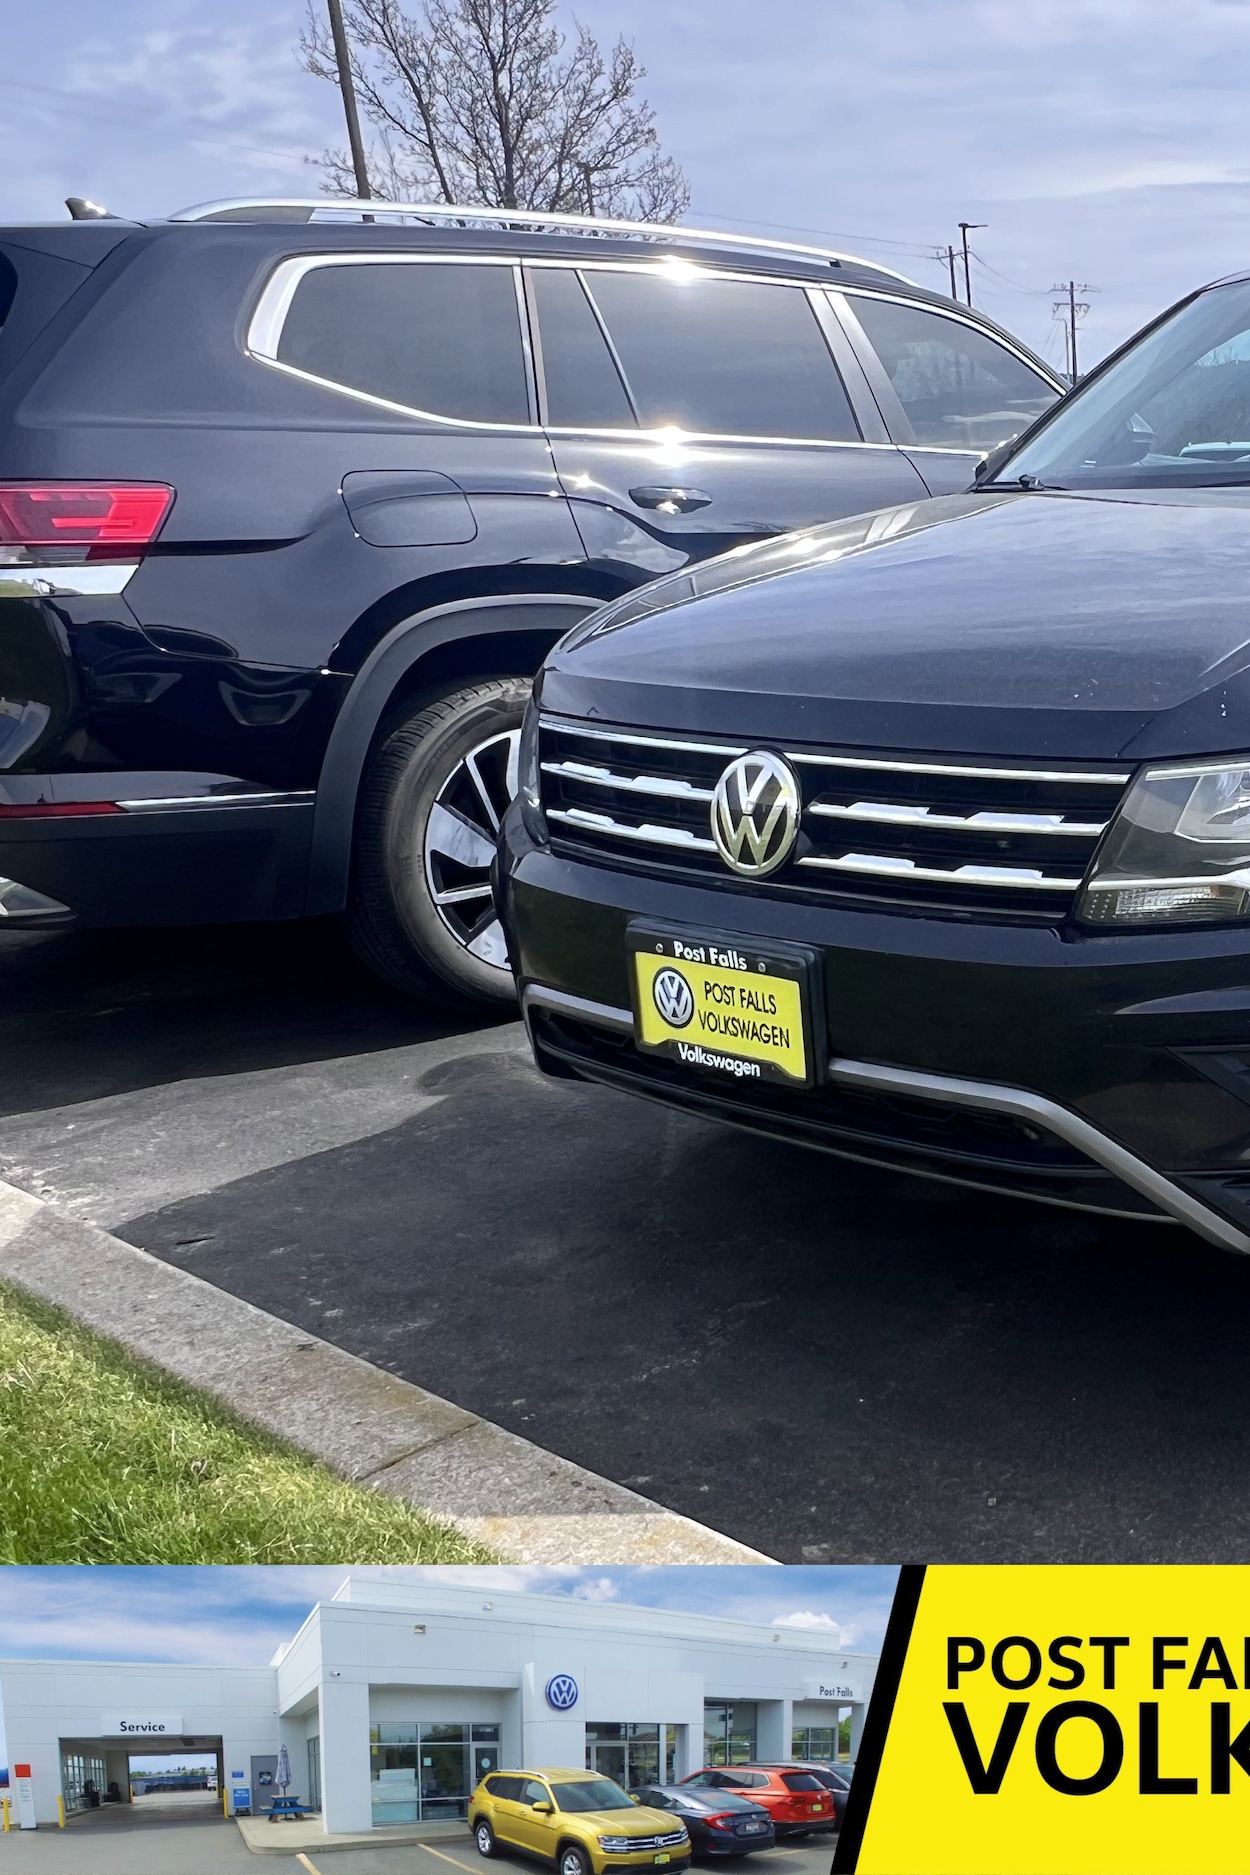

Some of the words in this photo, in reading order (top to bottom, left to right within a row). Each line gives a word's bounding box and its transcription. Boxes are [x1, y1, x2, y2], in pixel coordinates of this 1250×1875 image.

[711, 750, 801, 876] VW
[673, 941, 706, 962] Post
[709, 947, 748, 970] Falls
[653, 966, 694, 1028] VW
[704, 980, 735, 1007] POST
[739, 987, 777, 1015] FALLS
[698, 1009, 790, 1049] VOLKSWAGEN
[678, 1043, 761, 1077] Volkswagen
[548, 1674, 578, 1710] VW
[819, 1685, 835, 1696] Post
[836, 1686, 854, 1697] Falls
[119, 1720, 166, 1732] Service
